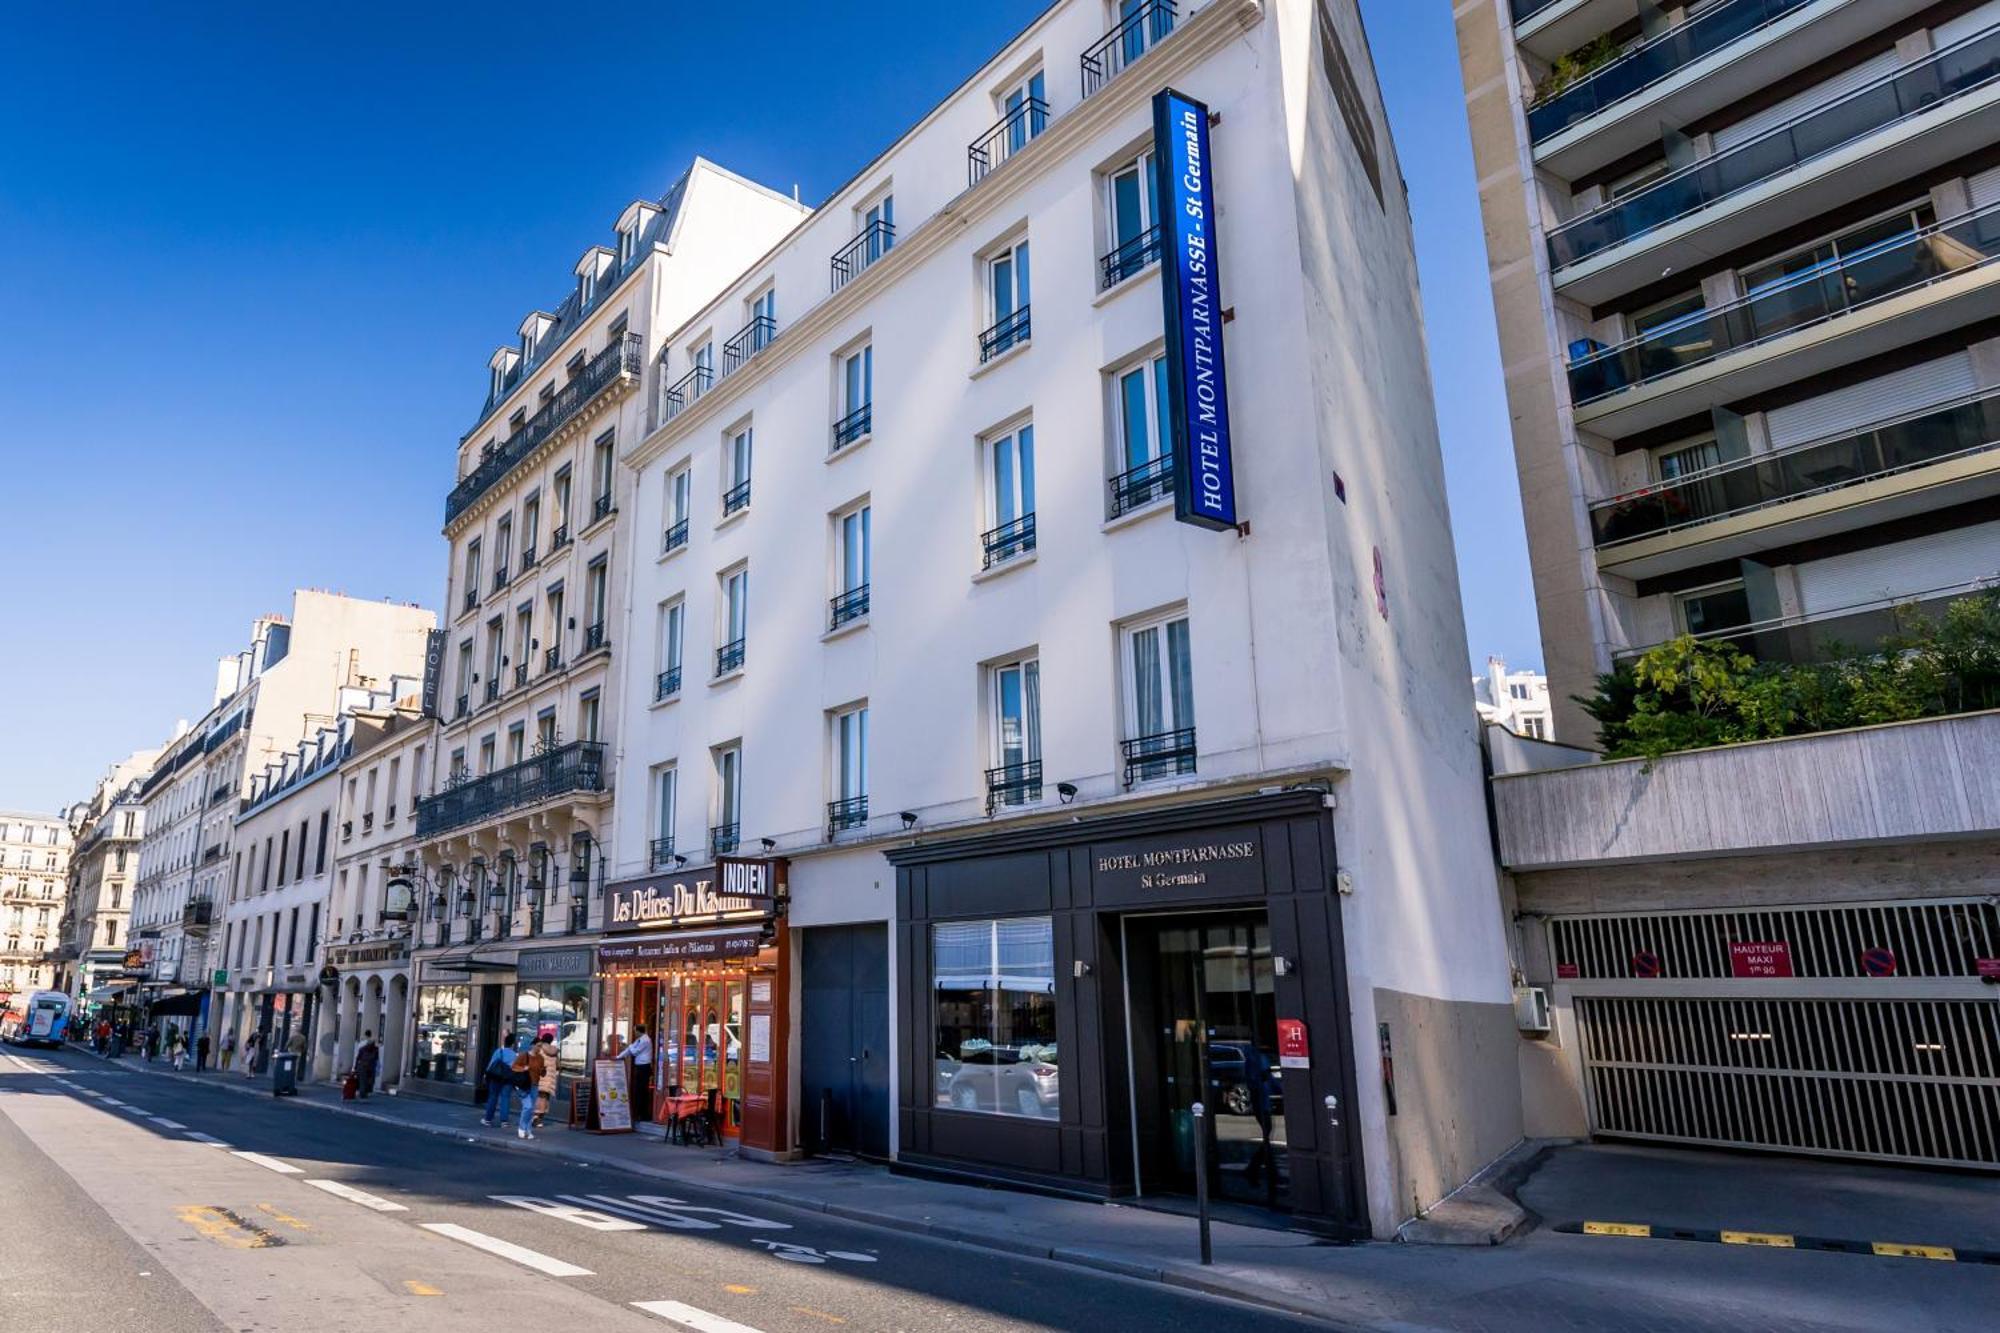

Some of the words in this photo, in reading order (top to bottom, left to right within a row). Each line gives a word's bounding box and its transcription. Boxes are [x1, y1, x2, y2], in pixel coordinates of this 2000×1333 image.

[1180, 111, 1202, 193] Germain
[1186, 195, 1204, 220] St
[1187, 234, 1217, 425] MONTPARNASSE
[1200, 431, 1222, 511] HOTEL
[424, 638, 441, 709] HOTEL
[1099, 855, 1141, 872] HOTEL
[1143, 842, 1254, 867] MONTPARNASSE
[723, 862, 766, 896] INDIEN
[1141, 874, 1153, 888] St
[1155, 870, 1206, 887] Germain
[613, 892, 631, 922] Les
[632, 886, 673, 921] Délices
[673, 884, 696, 916] Du
[1734, 945, 1784, 954] HAUTEUR
[1747, 956, 1773, 964] MAXI
[1291, 1027, 1301, 1040] H
[487, 1195, 794, 1231] BUS
